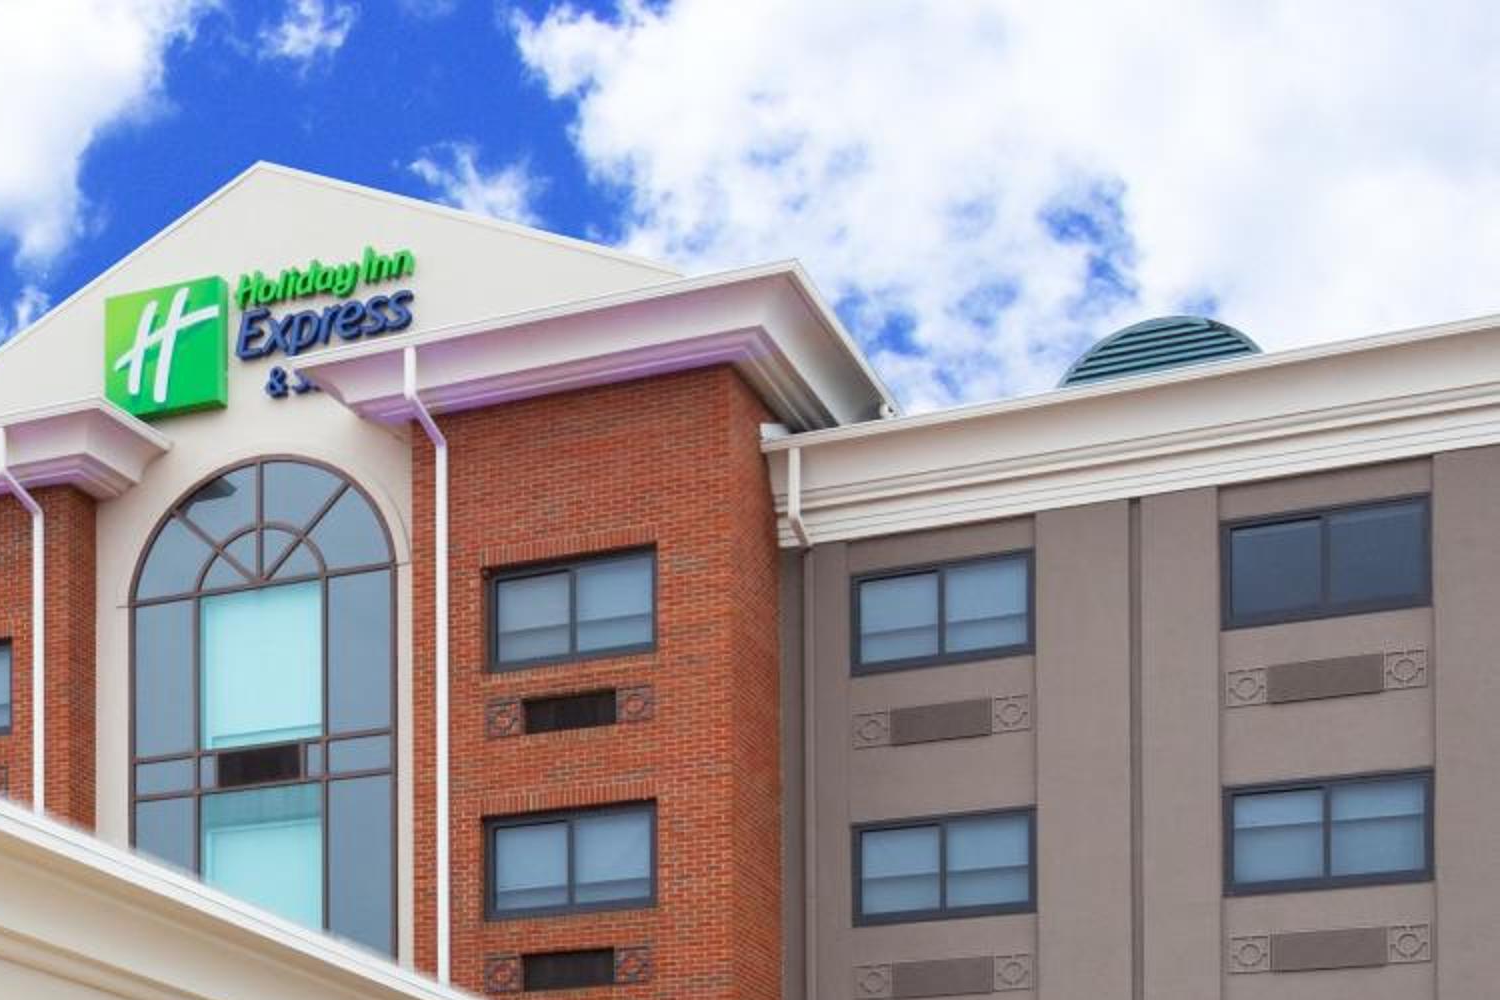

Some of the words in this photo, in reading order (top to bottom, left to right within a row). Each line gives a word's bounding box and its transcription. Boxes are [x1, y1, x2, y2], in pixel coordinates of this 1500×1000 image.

[236, 260, 358, 306] Holiday
[361, 247, 414, 284] Inn
[237, 290, 414, 360] Express
[265, 366, 289, 398] &
